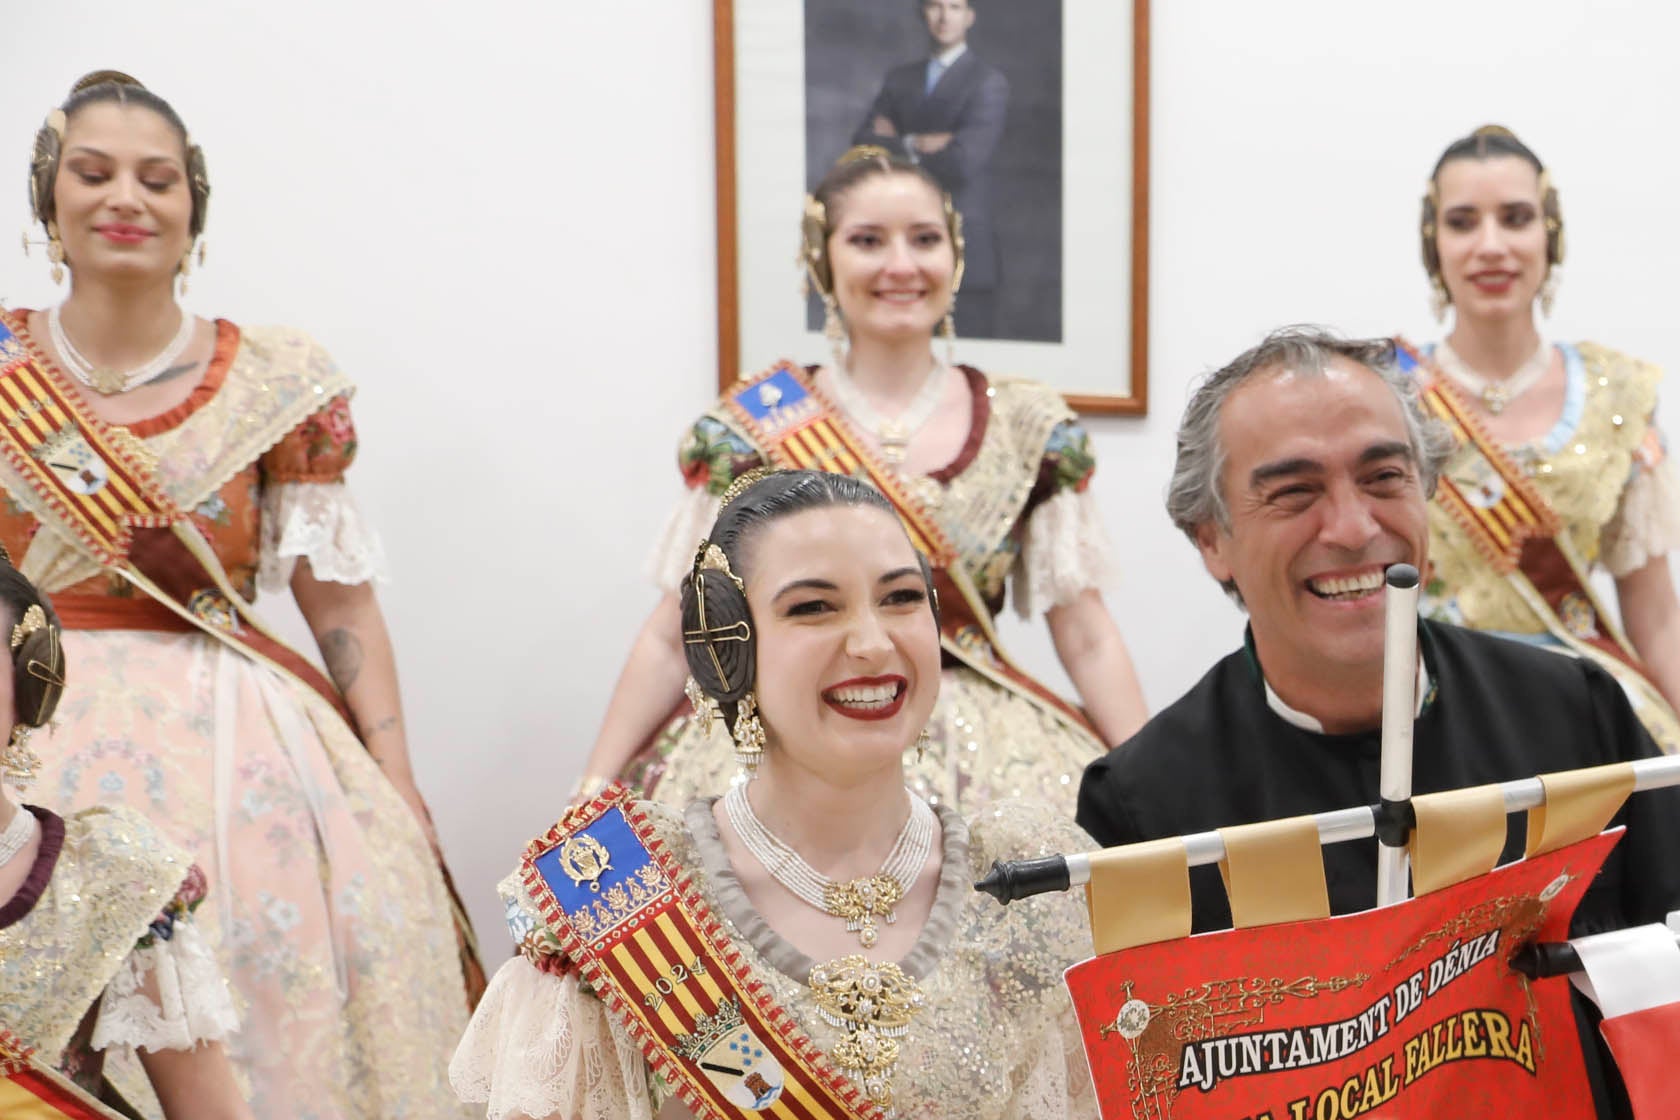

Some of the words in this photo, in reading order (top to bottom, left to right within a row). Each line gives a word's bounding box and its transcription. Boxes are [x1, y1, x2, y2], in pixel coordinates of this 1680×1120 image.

[644, 956, 706, 1011] 2024
[1178, 1003, 1391, 1093] AJUNTAMENT
[1393, 975, 1424, 1024] DE
[1426, 928, 1500, 997] DÉNIA
[1401, 1010, 1537, 1086] FALLERA
